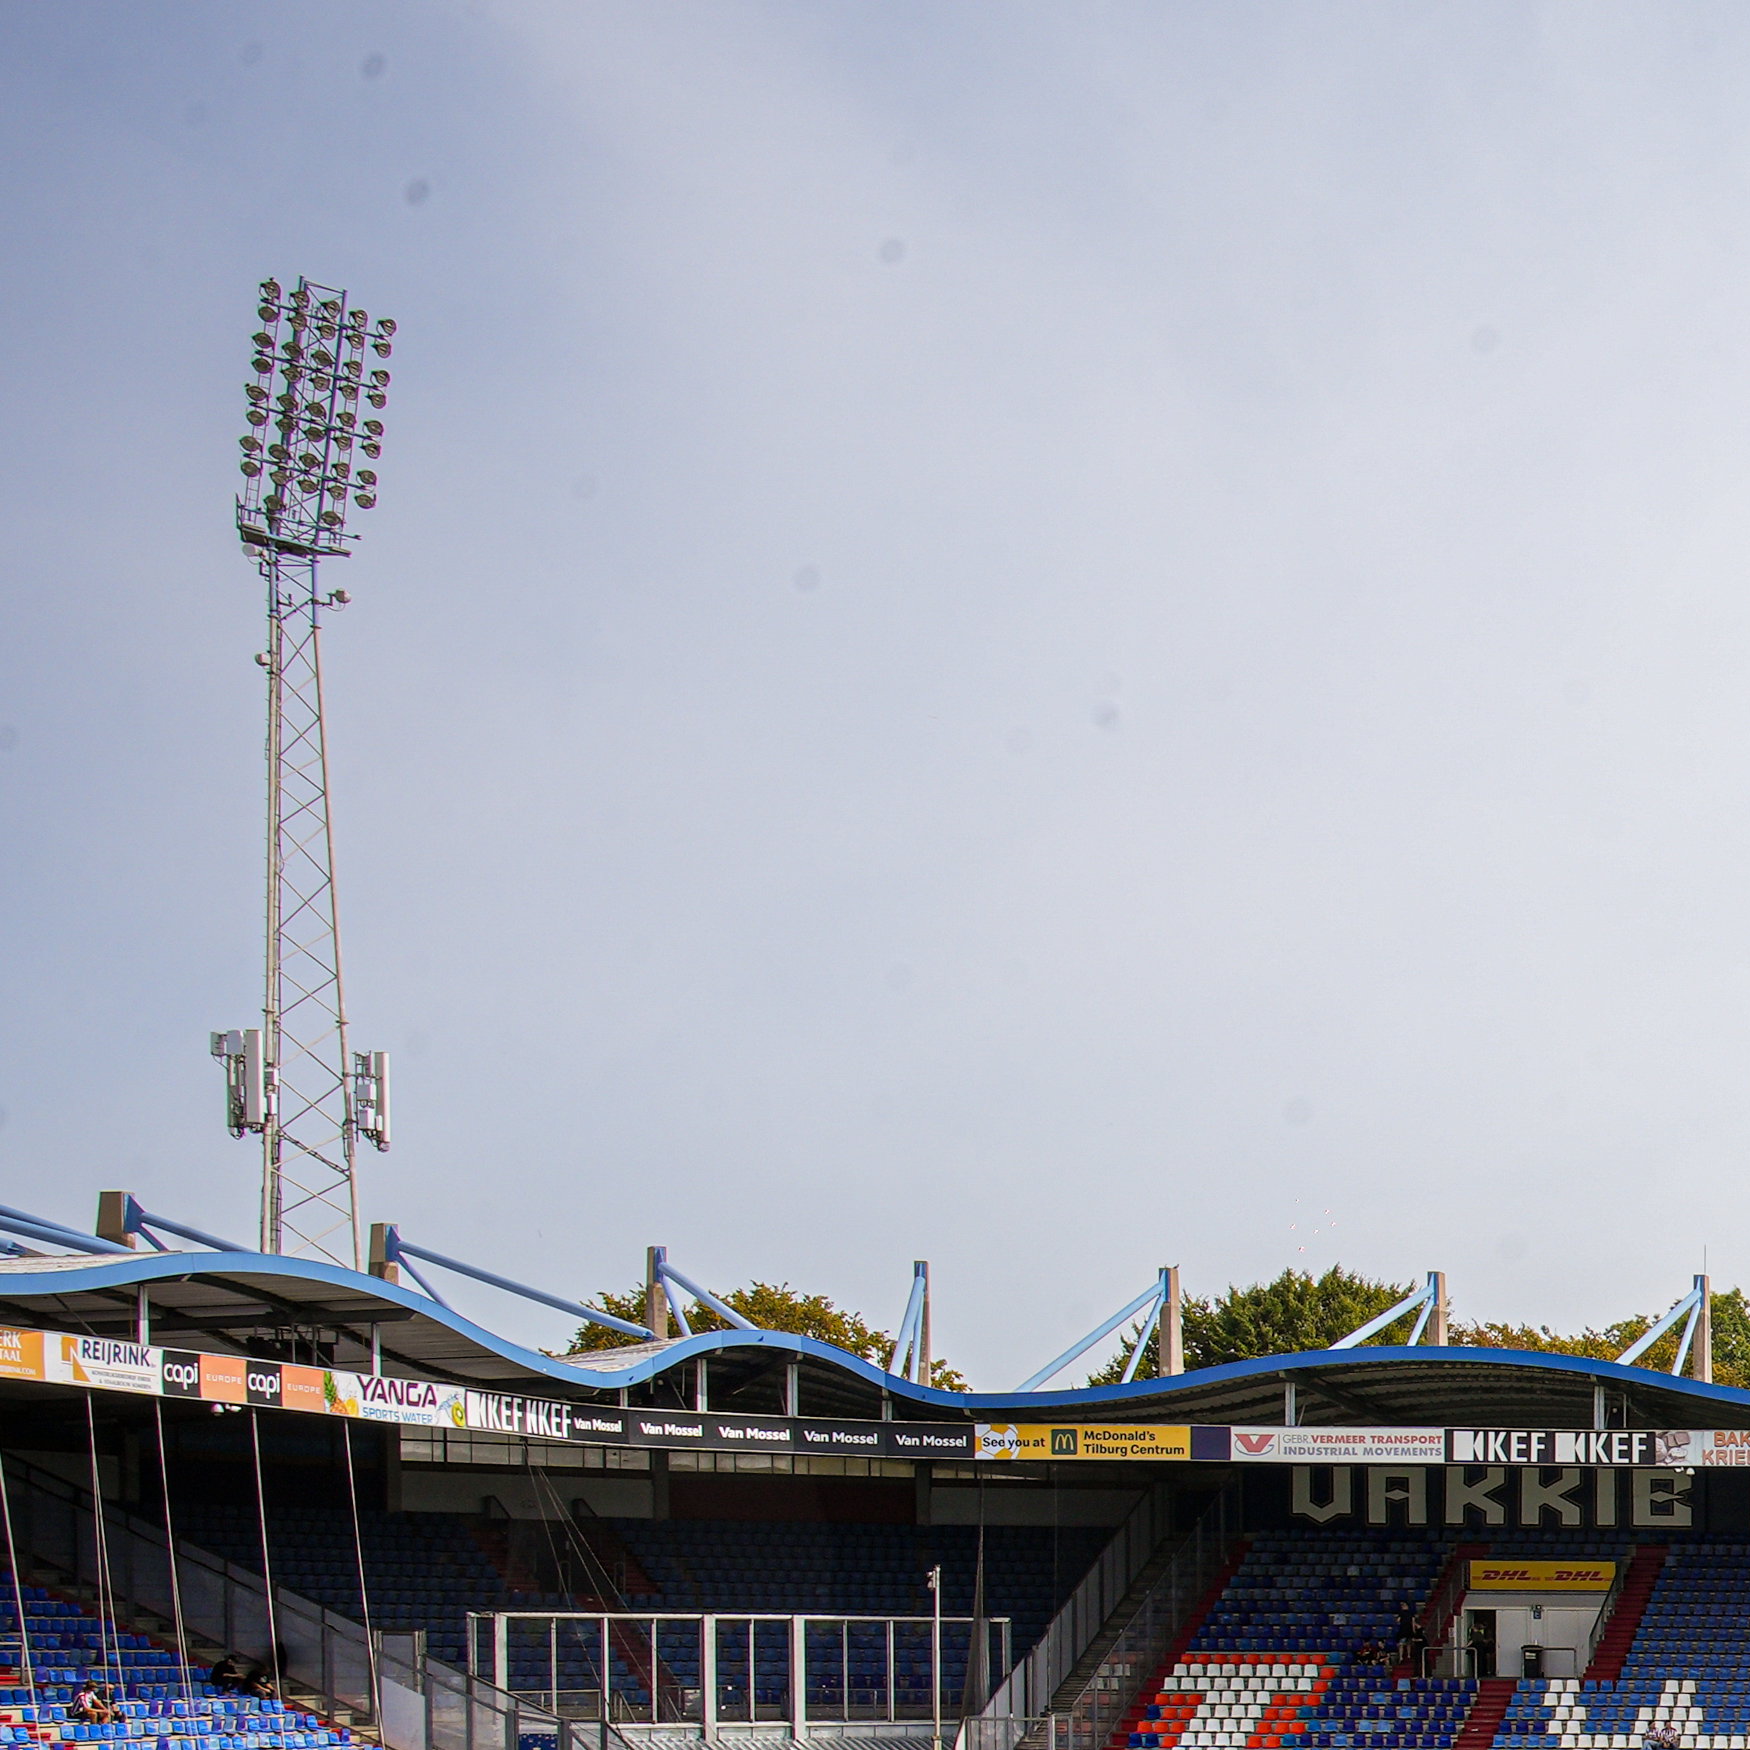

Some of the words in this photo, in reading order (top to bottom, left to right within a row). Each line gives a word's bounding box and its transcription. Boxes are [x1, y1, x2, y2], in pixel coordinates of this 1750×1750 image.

[81, 1339, 151, 1367] REIJRINK
[163, 1361, 199, 1391] capi
[205, 1373, 243, 1385] EUROPE
[247, 1371, 281, 1399] capi
[286, 1383, 322, 1395] EUROPE
[356, 1375, 438, 1408] YANGA
[362, 1407, 400, 1422] SPORTS
[401, 1411, 433, 1425] WATER
[574, 1417, 592, 1430] Van
[592, 1419, 622, 1434] Mossel
[895, 1433, 919, 1447] Van
[921, 1434, 967, 1448] Mossel
[982, 1436, 1005, 1448] See
[1006, 1438, 1031, 1452] you
[1032, 1437, 1046, 1449] at
[1083, 1443, 1128, 1457] Tilburg
[1129, 1443, 1186, 1456] Centrum
[1282, 1446, 1359, 1457] INDUSTRIAL
[1362, 1446, 1443, 1457] MOVEMENTS
[1481, 1569, 1531, 1581] DHL
